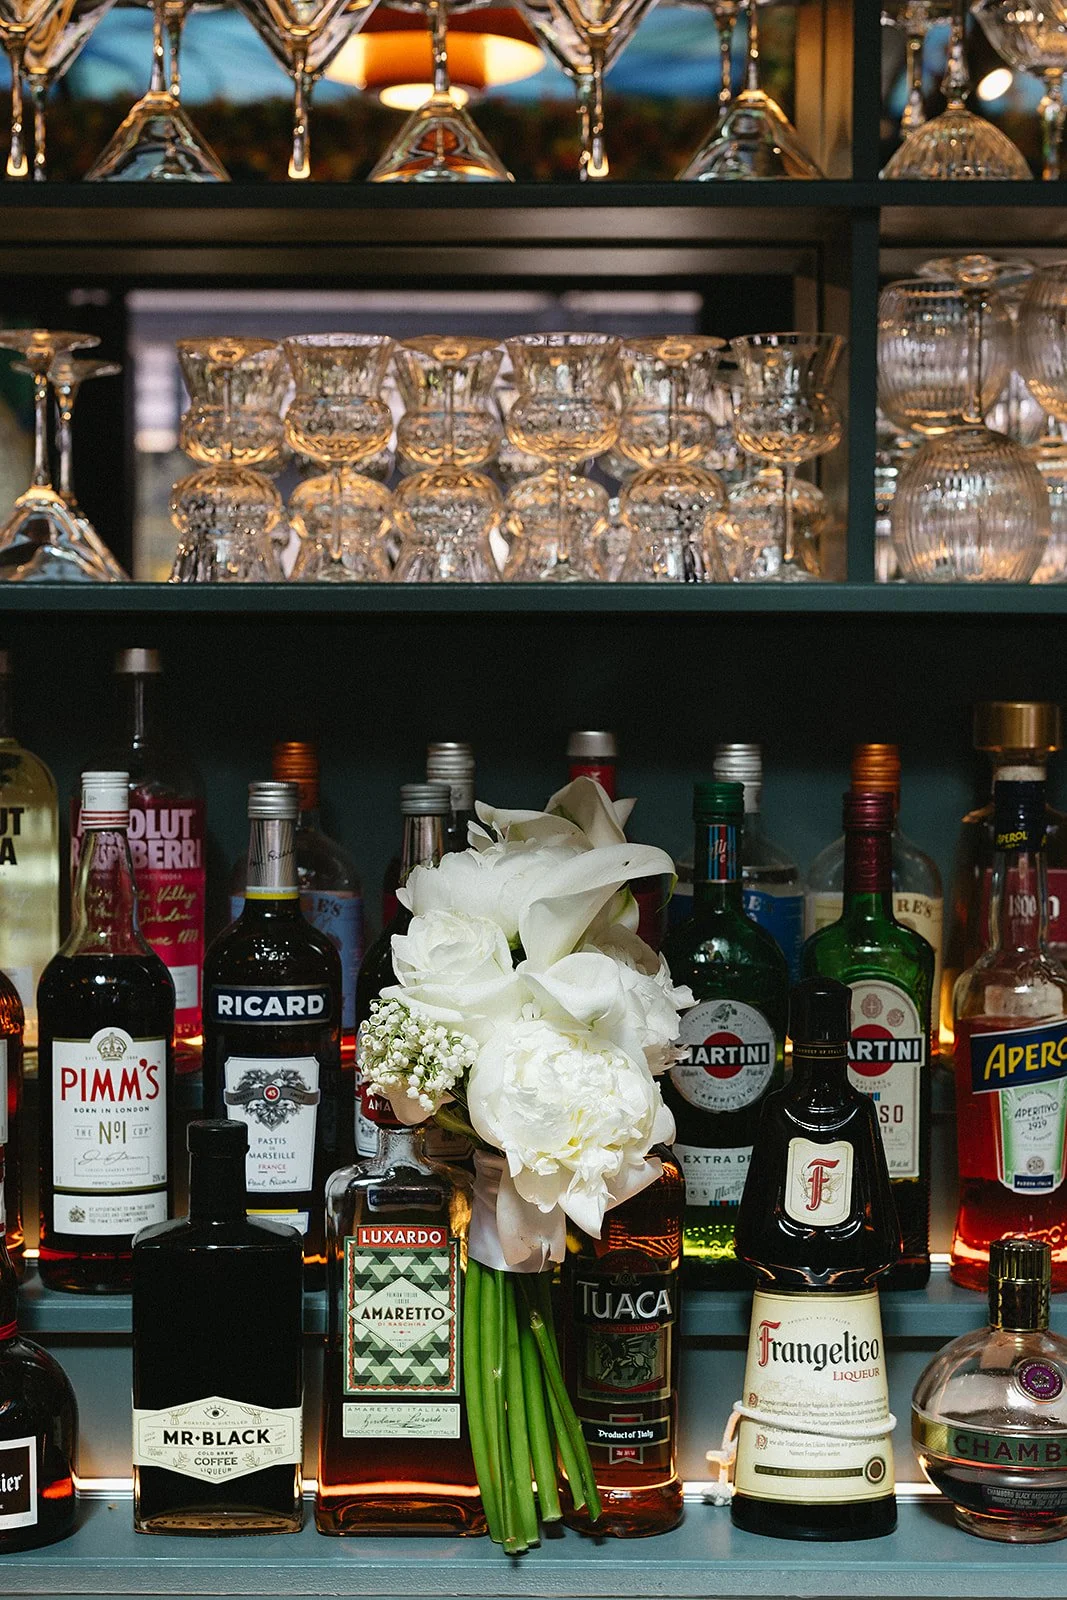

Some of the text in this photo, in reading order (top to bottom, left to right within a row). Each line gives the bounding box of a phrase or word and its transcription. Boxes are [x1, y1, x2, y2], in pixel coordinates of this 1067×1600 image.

[217, 994, 324, 1017] RICARD
[847, 1040, 919, 1061] ARTINI
[60, 1058, 160, 1102] PIMM'S
[115, 1105, 150, 1114] LONDON
[880, 1104, 904, 1124] SO
[1014, 1101, 1059, 1119] APERITIVO
[76, 1126, 92, 1137] THE
[1028, 1119, 1047, 1130] 1919
[683, 1155, 732, 1164] EXTRA
[361, 1230, 442, 1244] LUXARDO
[576, 1280, 673, 1320] TUACA
[361, 1307, 445, 1320] AMARETTO
[757, 1319, 879, 1372] Frangelico
[832, 1367, 880, 1383] LIQUEUR
[597, 1429, 654, 1440] Product of Italy
[953, 1434, 1067, 1463] CHAMB
[194, 1457, 238, 1466] COFFEE
[0, 1473, 23, 1493] ier
